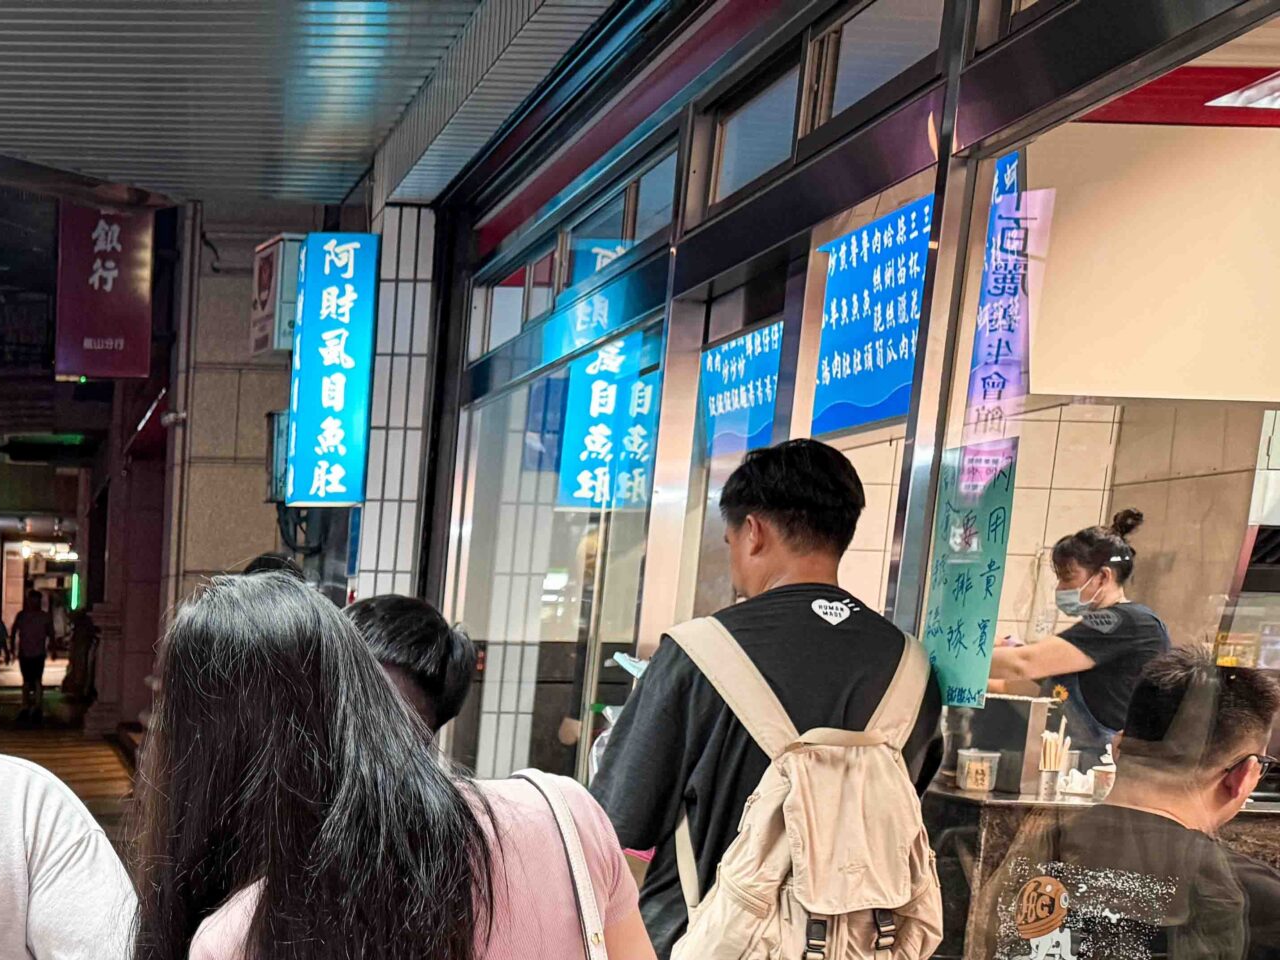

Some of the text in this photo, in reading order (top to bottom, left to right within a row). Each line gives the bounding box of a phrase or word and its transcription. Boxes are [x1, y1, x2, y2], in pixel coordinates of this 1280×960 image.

[88, 210, 124, 292] 銀行
[309, 239, 362, 497] 阿財虱目魚肚
[818, 604, 844, 612] HUMAN
